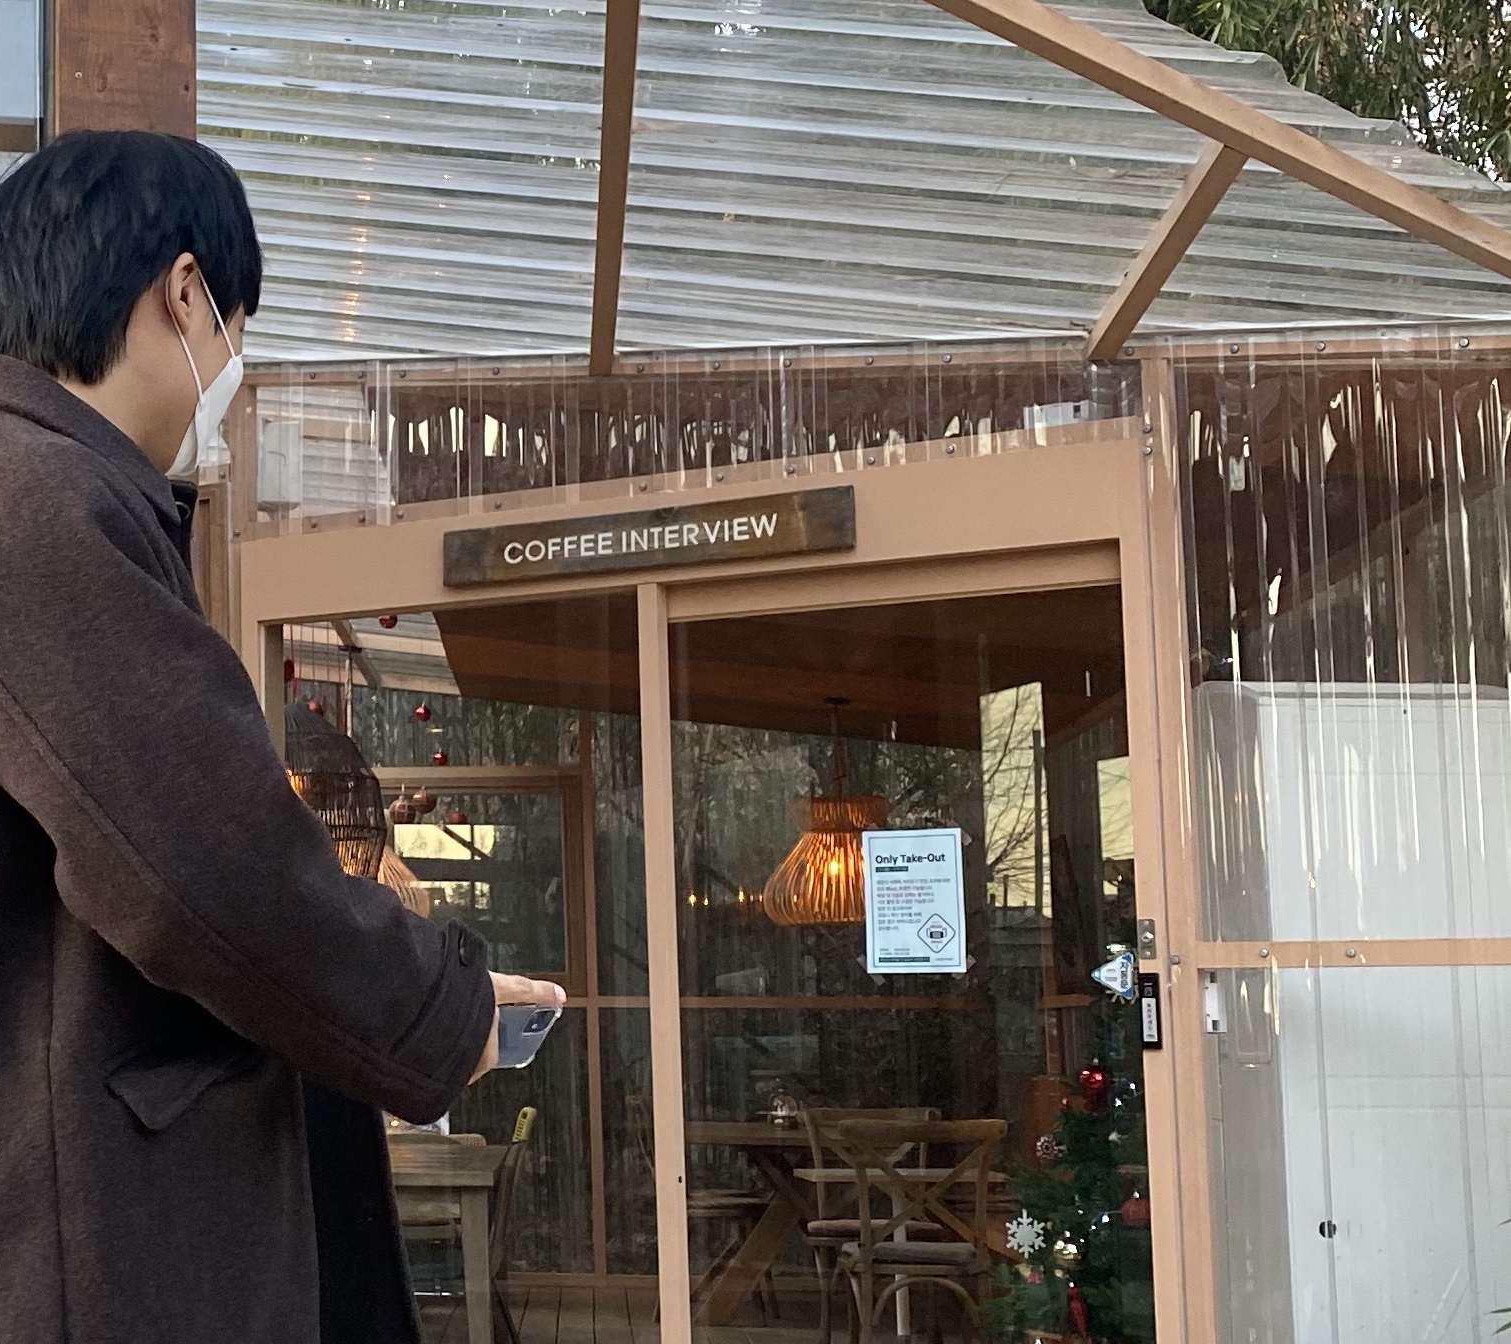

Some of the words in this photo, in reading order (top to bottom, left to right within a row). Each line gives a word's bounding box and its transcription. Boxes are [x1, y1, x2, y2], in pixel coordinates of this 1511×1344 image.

[503, 531, 614, 565] COFFEE
[621, 512, 779, 554] INTERVIEW
[875, 854, 898, 866] Only
[900, 853, 946, 864] Take-Out
